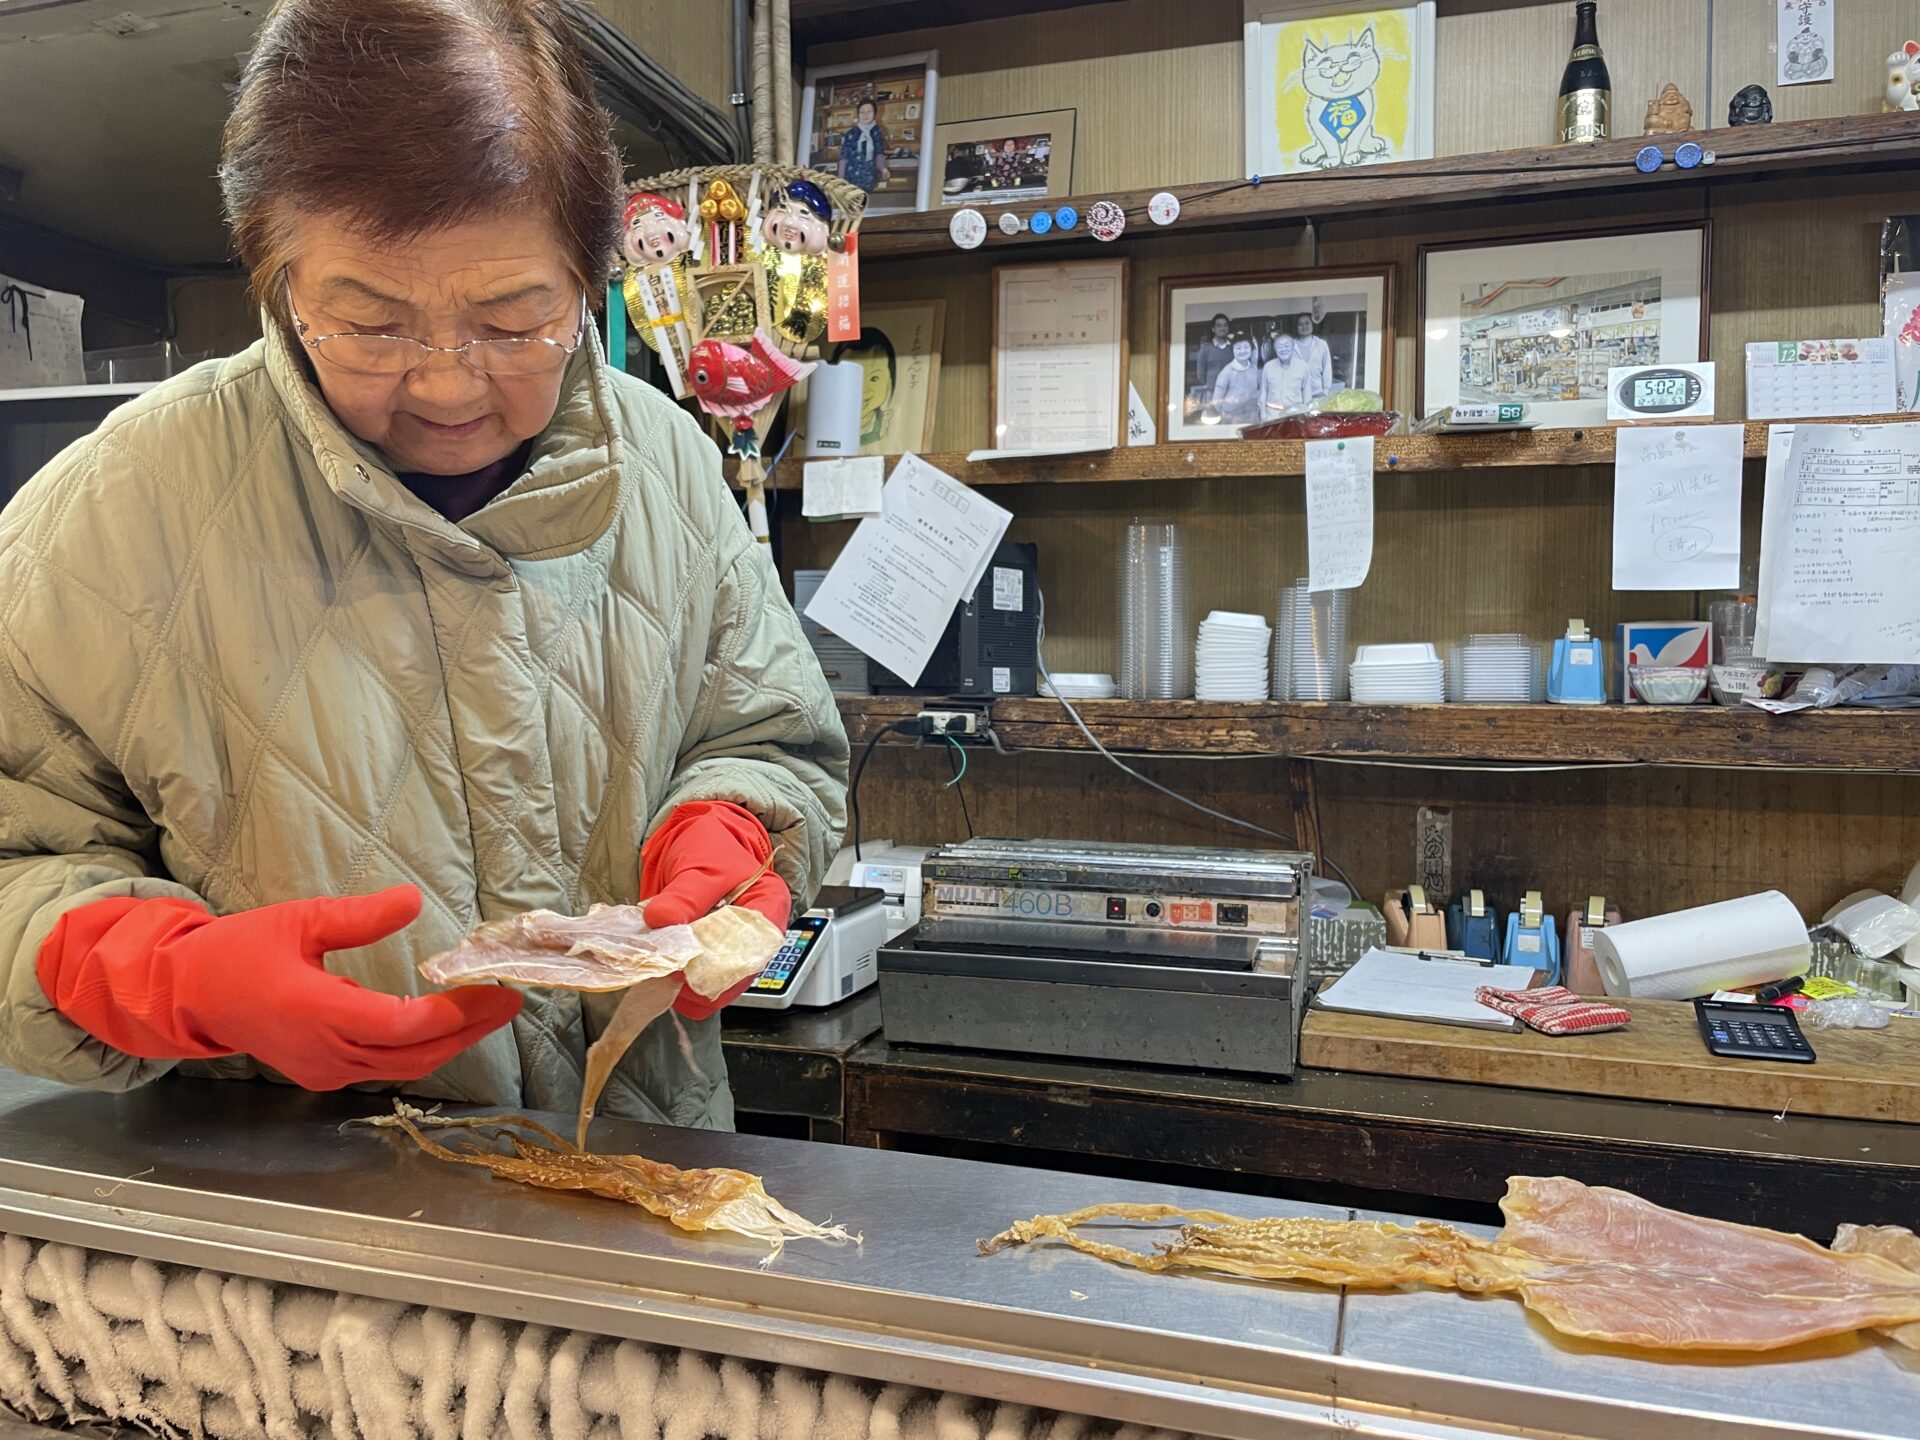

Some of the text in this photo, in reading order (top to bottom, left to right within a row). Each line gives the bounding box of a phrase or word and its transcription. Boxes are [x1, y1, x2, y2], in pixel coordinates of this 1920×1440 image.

[1574, 49, 1596, 57] YEBISU
[1328, 100, 1357, 127] 福
[1561, 124, 1607, 141] YEBISU
[1780, 350, 1796, 362] 12
[1645, 380, 1675, 395] 5:02
[1501, 407, 1521, 418] 85
[1424, 825, 1445, 892] 火の用心
[937, 886, 1000, 902] MULTI
[1003, 889, 1073, 917] 460B
